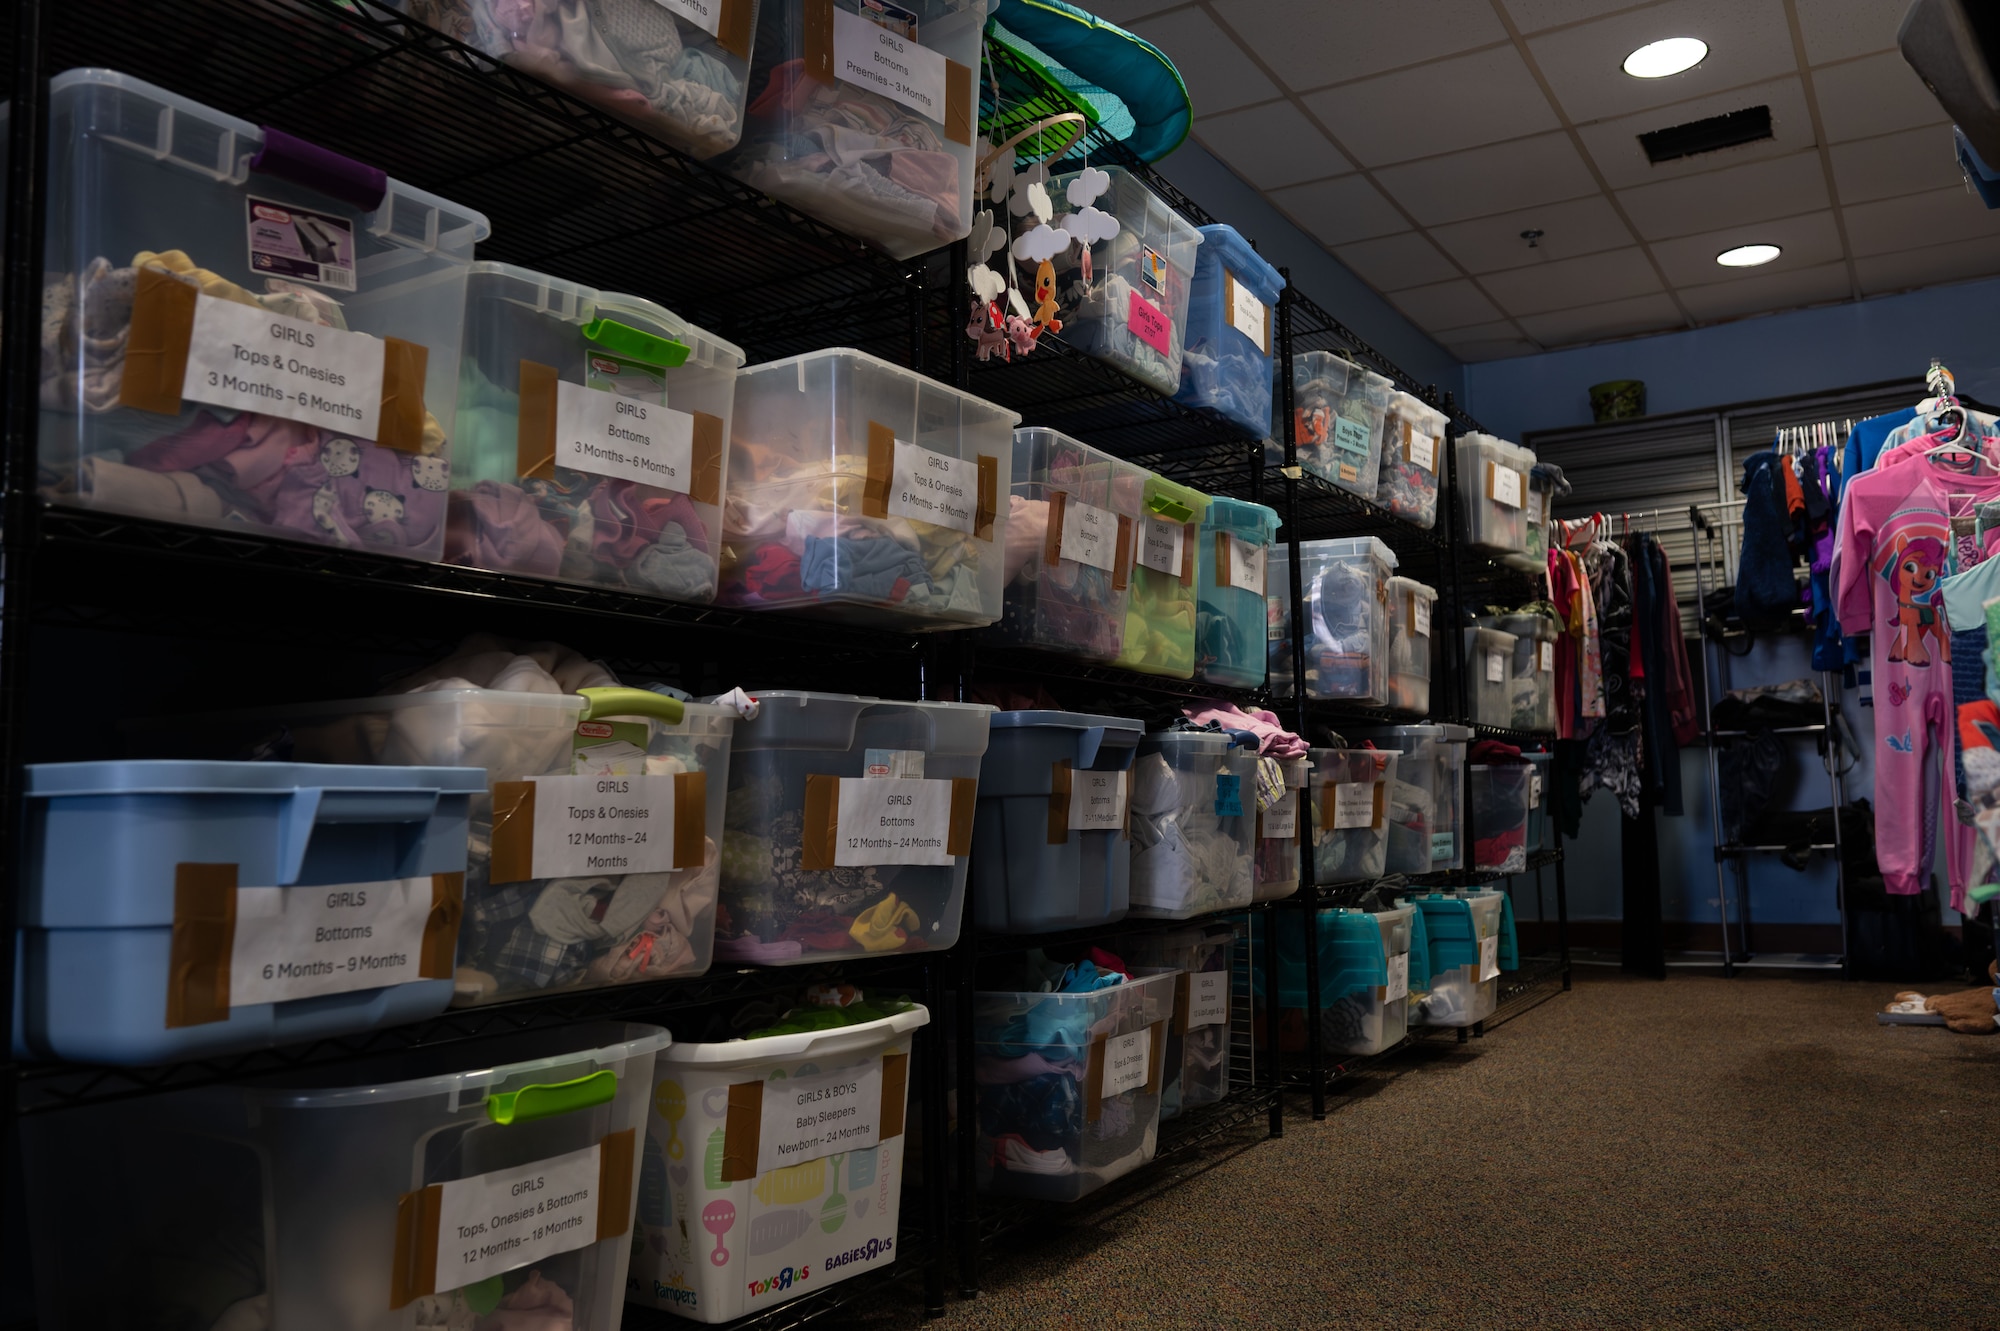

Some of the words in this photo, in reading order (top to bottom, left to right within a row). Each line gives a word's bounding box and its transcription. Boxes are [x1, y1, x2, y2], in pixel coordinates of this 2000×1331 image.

[879, 33, 904, 54] GIRLS
[874, 52, 909, 76] Bottoms
[847, 61, 888, 87] Preemies
[895, 80, 901, 92] 3
[902, 85, 932, 107] Months
[1138, 306, 1151, 323] Girls
[1150, 315, 1163, 333] Tops
[270, 323, 315, 348] GIRLS
[232, 344, 269, 368] Tops
[272, 356, 284, 370] &
[288, 359, 345, 386] Onesies
[208, 372, 218, 386] 3
[222, 374, 283, 401] Months
[298, 392, 308, 406] 6
[311, 395, 362, 421] Months
[616, 402, 647, 420] GIRLS
[608, 424, 650, 446] Bottoms
[575, 441, 582, 453] 3
[584, 444, 624, 463] Months
[633, 455, 639, 466] 6
[641, 458, 675, 477] Months
[928, 456, 949, 471] GIRLS
[914, 473, 928, 488] Tops
[929, 479, 933, 488] &
[935, 480, 963, 497] Onesies
[902, 492, 908, 503] 6
[910, 495, 933, 510] Months
[940, 502, 945, 513] 9
[945, 504, 968, 520] Months
[1085, 513, 1098, 525] GIRLS
[1156, 524, 1169, 535] GIRLS
[1080, 529, 1099, 543] Bottoms
[597, 781, 629, 793] GIRLS
[887, 795, 912, 805] GIRLS
[568, 806, 595, 820] Tops
[598, 807, 606, 818] &
[609, 807, 649, 819] Onesies
[880, 817, 915, 827] Bottoms
[568, 834, 582, 845] 12
[585, 833, 625, 844] Months
[634, 832, 647, 843] 24
[848, 838, 858, 848] 12
[860, 838, 892, 848] Months
[900, 838, 910, 848] 24
[911, 838, 941, 847] Months
[587, 856, 628, 868] Months
[326, 891, 367, 909] GIRLS
[315, 925, 372, 943] Bottoms
[262, 964, 272, 980] 6
[277, 960, 333, 979] Months
[347, 956, 356, 971] 9
[359, 952, 407, 971] Months
[797, 1092, 823, 1106] GIRLS
[825, 1090, 831, 1100] &
[833, 1082, 857, 1097] BOYS
[796, 1114, 818, 1129] Baby
[818, 1105, 856, 1125] Sleepers
[778, 1136, 819, 1155] Newborn
[826, 1131, 837, 1144] 24
[838, 1124, 870, 1141] Months
[511, 1177, 544, 1197] GIRLS
[457, 1222, 488, 1240] Tops,
[491, 1205, 534, 1229] Onesies
[537, 1202, 544, 1214] &
[546, 1189, 588, 1211] Bottoms
[463, 1250, 477, 1265] 12
[480, 1238, 521, 1259] Months
[532, 1229, 544, 1241] 18
[545, 1215, 583, 1237] Months
[654, 1279, 697, 1306] Pampers
